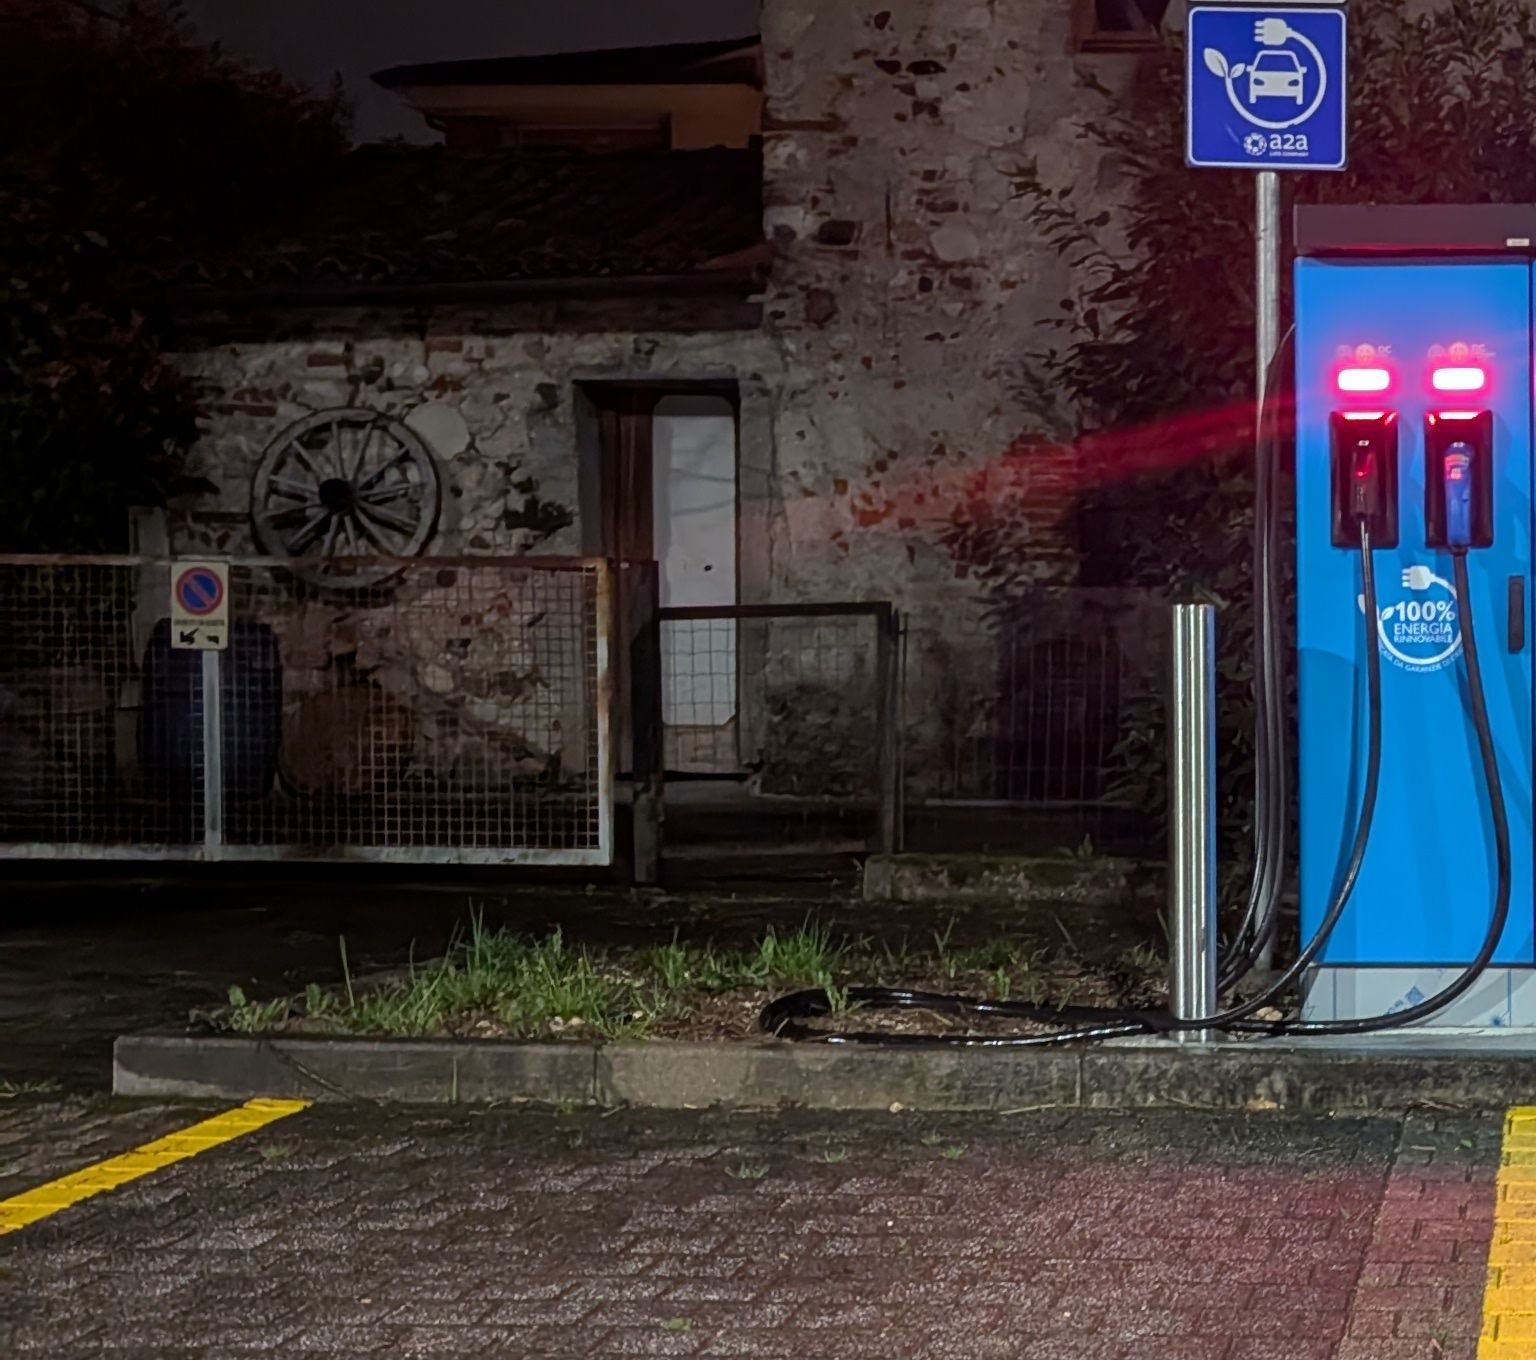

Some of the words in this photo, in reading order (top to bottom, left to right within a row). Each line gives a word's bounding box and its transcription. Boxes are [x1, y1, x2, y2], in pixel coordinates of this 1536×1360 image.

[1269, 133, 1309, 151] a2a
[1395, 601, 1456, 621] 100%
[1394, 623, 1453, 635] ENERGIA
